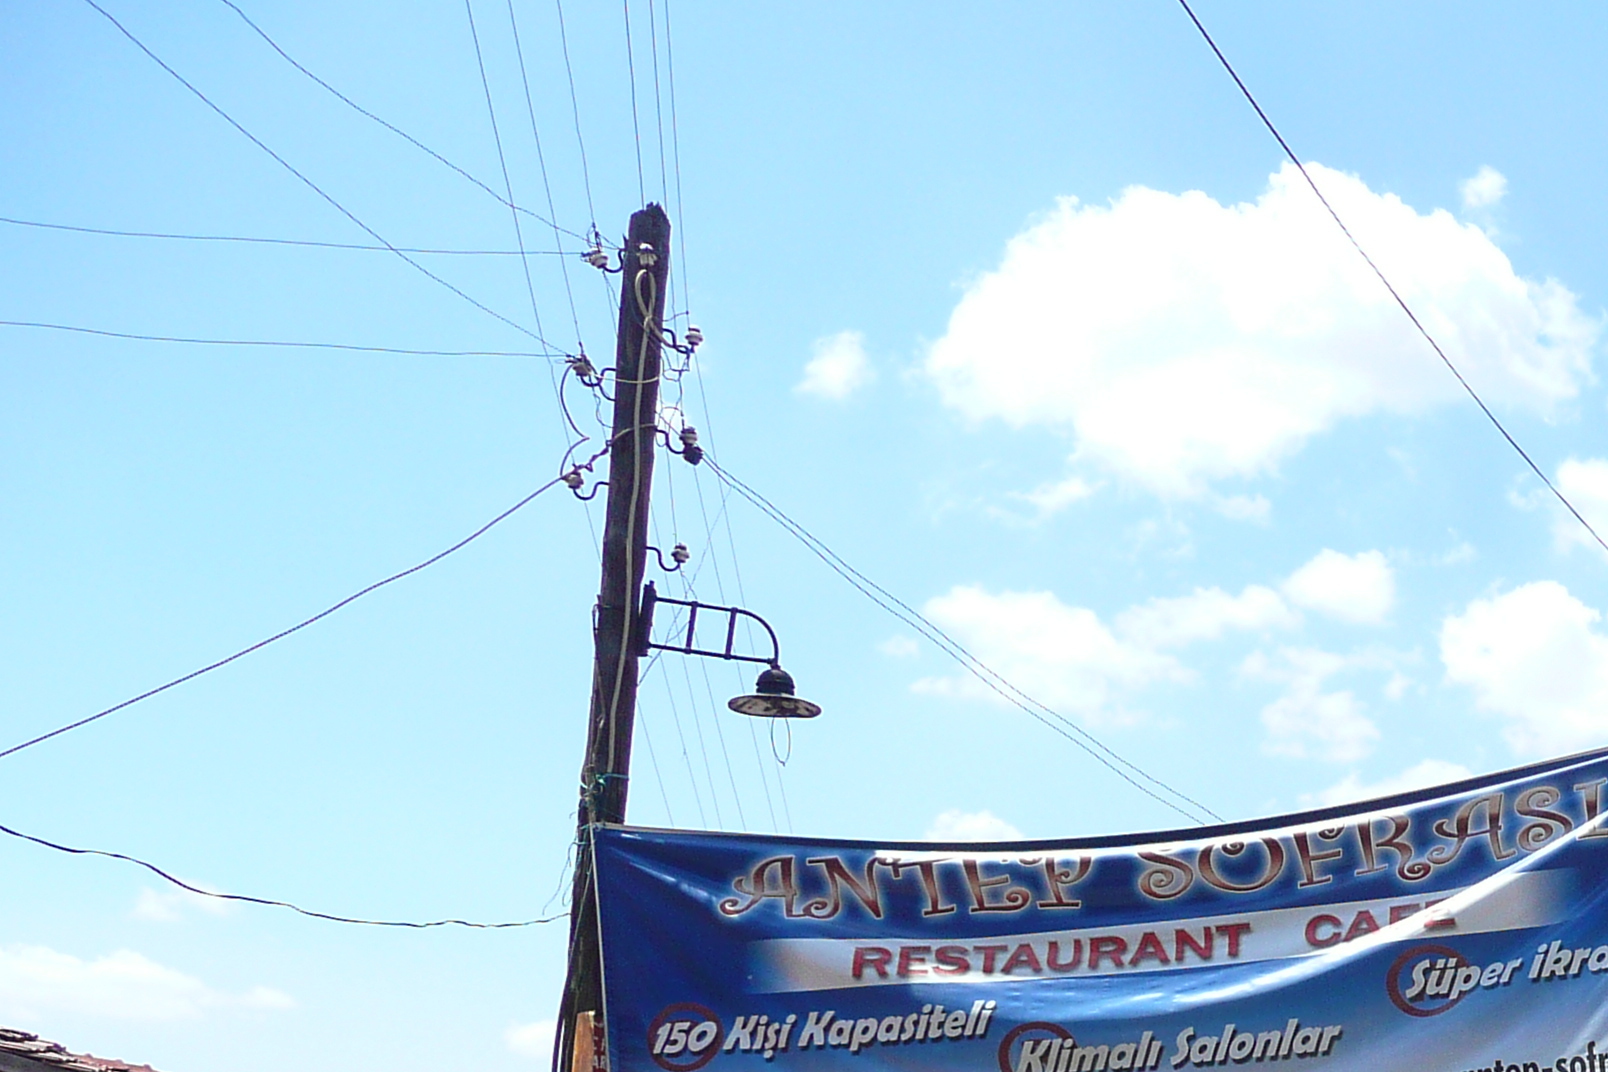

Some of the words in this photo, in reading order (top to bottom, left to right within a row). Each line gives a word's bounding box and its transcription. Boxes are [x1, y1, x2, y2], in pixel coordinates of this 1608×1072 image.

[718, 853, 1092, 919] ANTEP
[851, 922, 1251, 979] RESTAURANT
[1405, 954, 1522, 1002] Süper
[652, 1018, 718, 1056] 150
[723, 1010, 794, 1058] Kişi
[798, 999, 996, 1053] Kapasiteli
[1170, 1018, 1342, 1067] Salonlar
